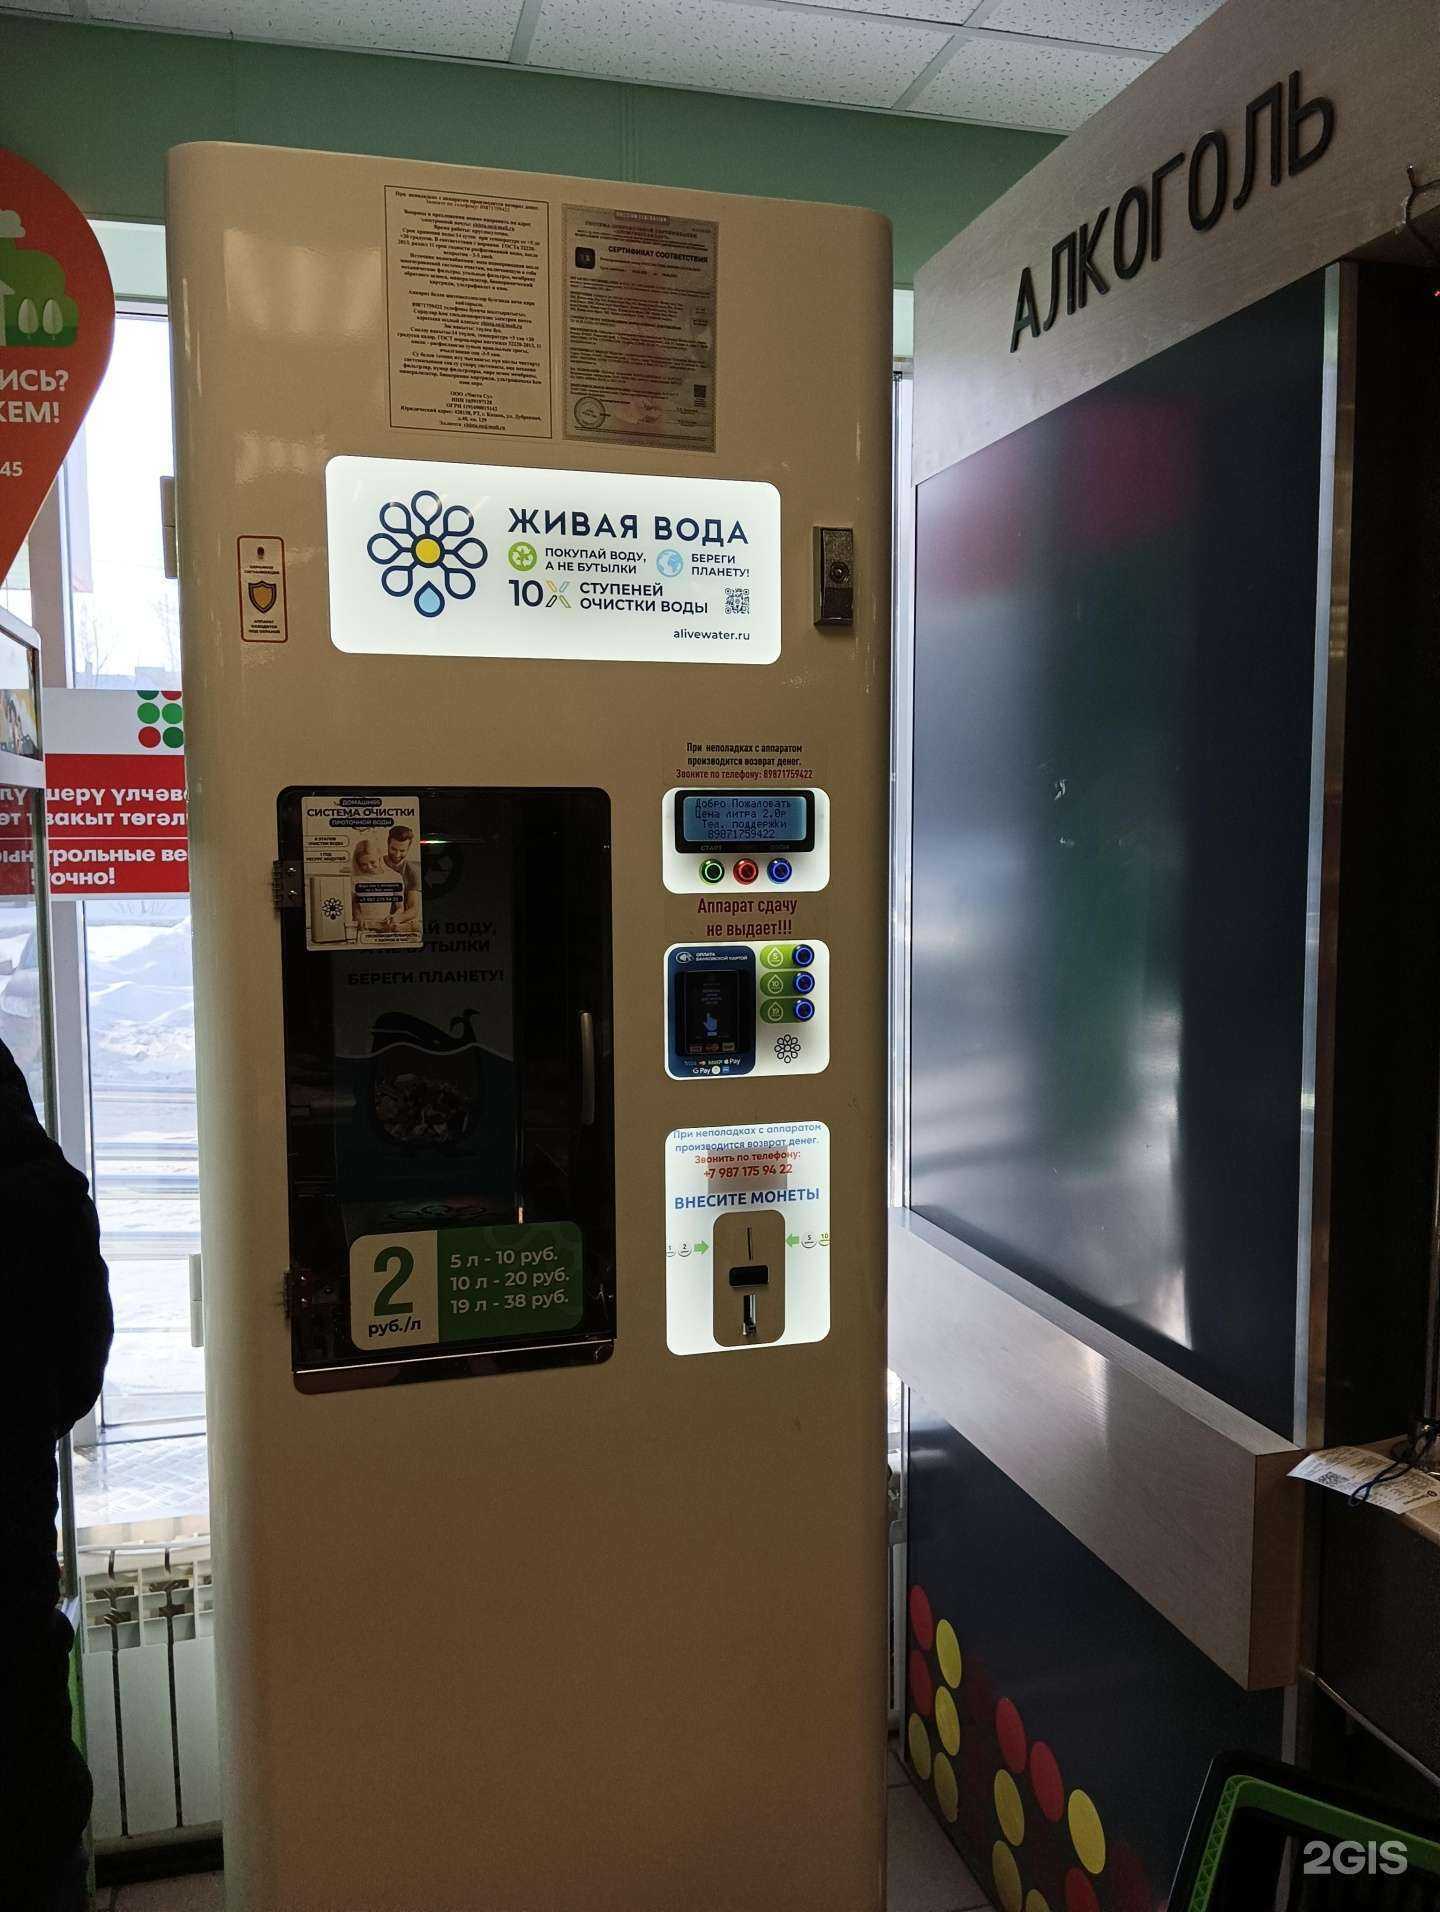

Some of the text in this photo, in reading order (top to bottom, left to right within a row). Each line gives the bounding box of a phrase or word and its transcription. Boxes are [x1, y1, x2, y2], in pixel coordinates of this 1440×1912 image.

[1009, 70, 1338, 354] АЛКОГОЛЬ
[608, 246, 708, 263] СЕРТИФИКАТ СООТВЕТСТВИЯ
[508, 507, 749, 547] ЖИВАЯ ВОДА
[545, 546, 647, 563] ПОКУПАЙ ВОДУ,
[691, 553, 736, 564] БЕРЕГИ
[545, 562, 637, 574] А НЕ БУТЫЛКИ
[691, 566, 750, 578] ПЛАНЕТУ!
[579, 582, 664, 597] СТУПЕНЕЙ
[580, 598, 708, 615] ОЧИСТКИ ВОДЫ
[673, 628, 750, 641] alivewater.ru
[687, 742, 702, 754] При
[706, 744, 753, 754] неполадках
[761, 744, 803, 754] аппаратом
[687, 757, 802, 767] производится возврат денег.
[676, 769, 709, 778] Звоните
[722, 769, 762, 781] телефону:
[763, 769, 813, 779] 89871759422
[696, 799, 791, 809] Добро Пожаловать
[307, 808, 415, 817] СИСТЕМА ОЧИСТКИ
[696, 809, 720, 819] Цена
[726, 810, 757, 818] литра
[702, 820, 787, 830] Тел. поддержки
[708, 829, 775, 839] 89871759422
[698, 897, 797, 916] Аппарат сдачу
[446, 920, 497, 935] ВОДУ,
[707, 920, 792, 938] не выдает!!!
[348, 969, 505, 986] БЕРЕГИ ПЛАНЕТУ!
[673, 1129, 694, 1141] При
[696, 1126, 756, 1139] неполадках
[766, 1124, 822, 1136] аппаратом
[675, 1137, 819, 1154] производится возврат денег.
[694, 1151, 801, 1165] Звонить по телефону:
[703, 1164, 793, 1179] +7 987 175 94 22
[674, 1188, 820, 1210] ВНЕСИТЕ МОНЕТЫ
[451, 1254, 461, 1268] 5
[466, 1255, 479, 1267] л
[496, 1250, 515, 1265] 10
[520, 1246, 558, 1266] руб.
[373, 1246, 415, 1316] 2
[450, 1276, 470, 1291] 10
[475, 1276, 488, 1289] л
[504, 1271, 527, 1287] 20
[532, 1267, 570, 1287] руб.
[450, 1299, 470, 1314] 19
[474, 1299, 487, 1312] л
[504, 1294, 526, 1309] 38
[532, 1289, 569, 1309] руб.
[368, 1316, 421, 1338] руб./л
